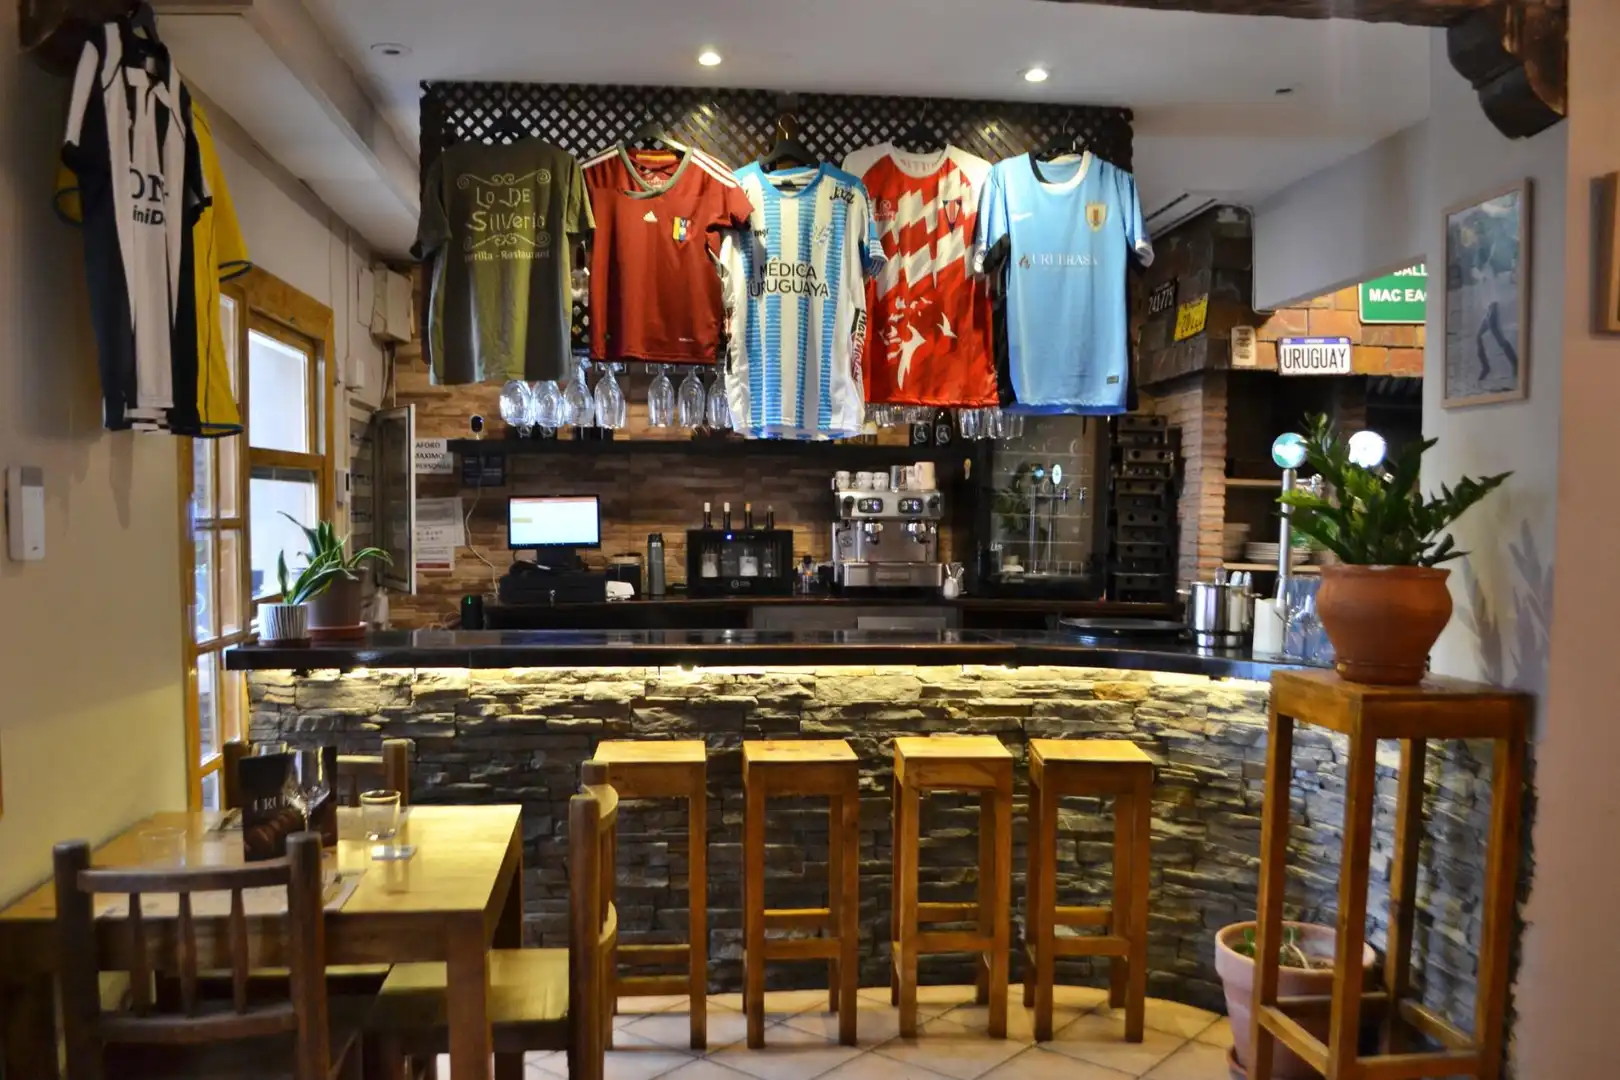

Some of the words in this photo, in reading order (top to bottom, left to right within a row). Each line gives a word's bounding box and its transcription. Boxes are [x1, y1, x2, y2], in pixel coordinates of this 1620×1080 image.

[499, 187, 531, 208] DE
[760, 257, 818, 280] MÉDICA
[749, 279, 829, 298] URUGUAYA
[1368, 287, 1403, 303] MAC
[1282, 346, 1347, 370] URUGUAY
[416, 441, 441, 449] AFORO
